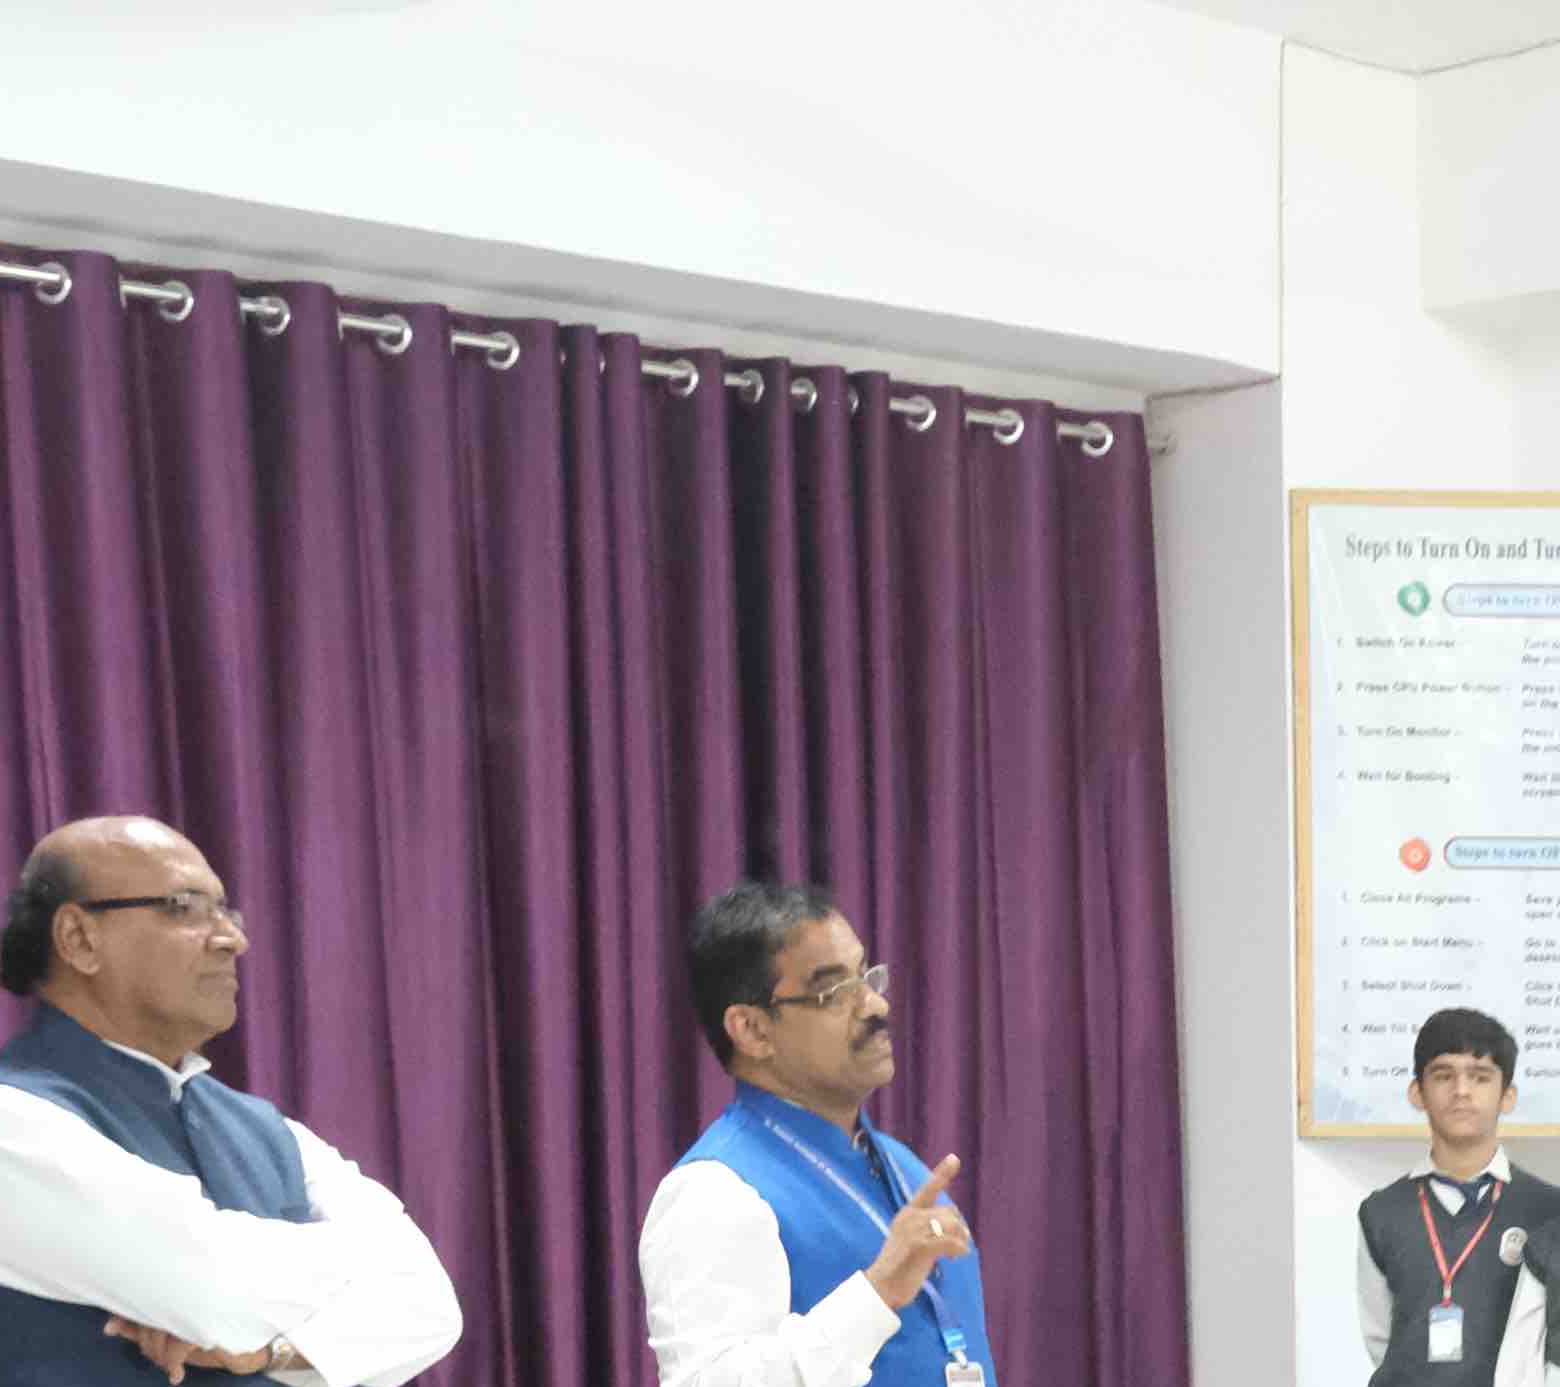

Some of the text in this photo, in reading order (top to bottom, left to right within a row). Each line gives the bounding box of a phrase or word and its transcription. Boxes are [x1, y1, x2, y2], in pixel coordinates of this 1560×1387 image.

[1344, 535, 1391, 563] Steps
[1396, 538, 1413, 558] to
[1418, 537, 1458, 559] Turn
[1464, 537, 1490, 559] On
[1495, 538, 1527, 559] and
